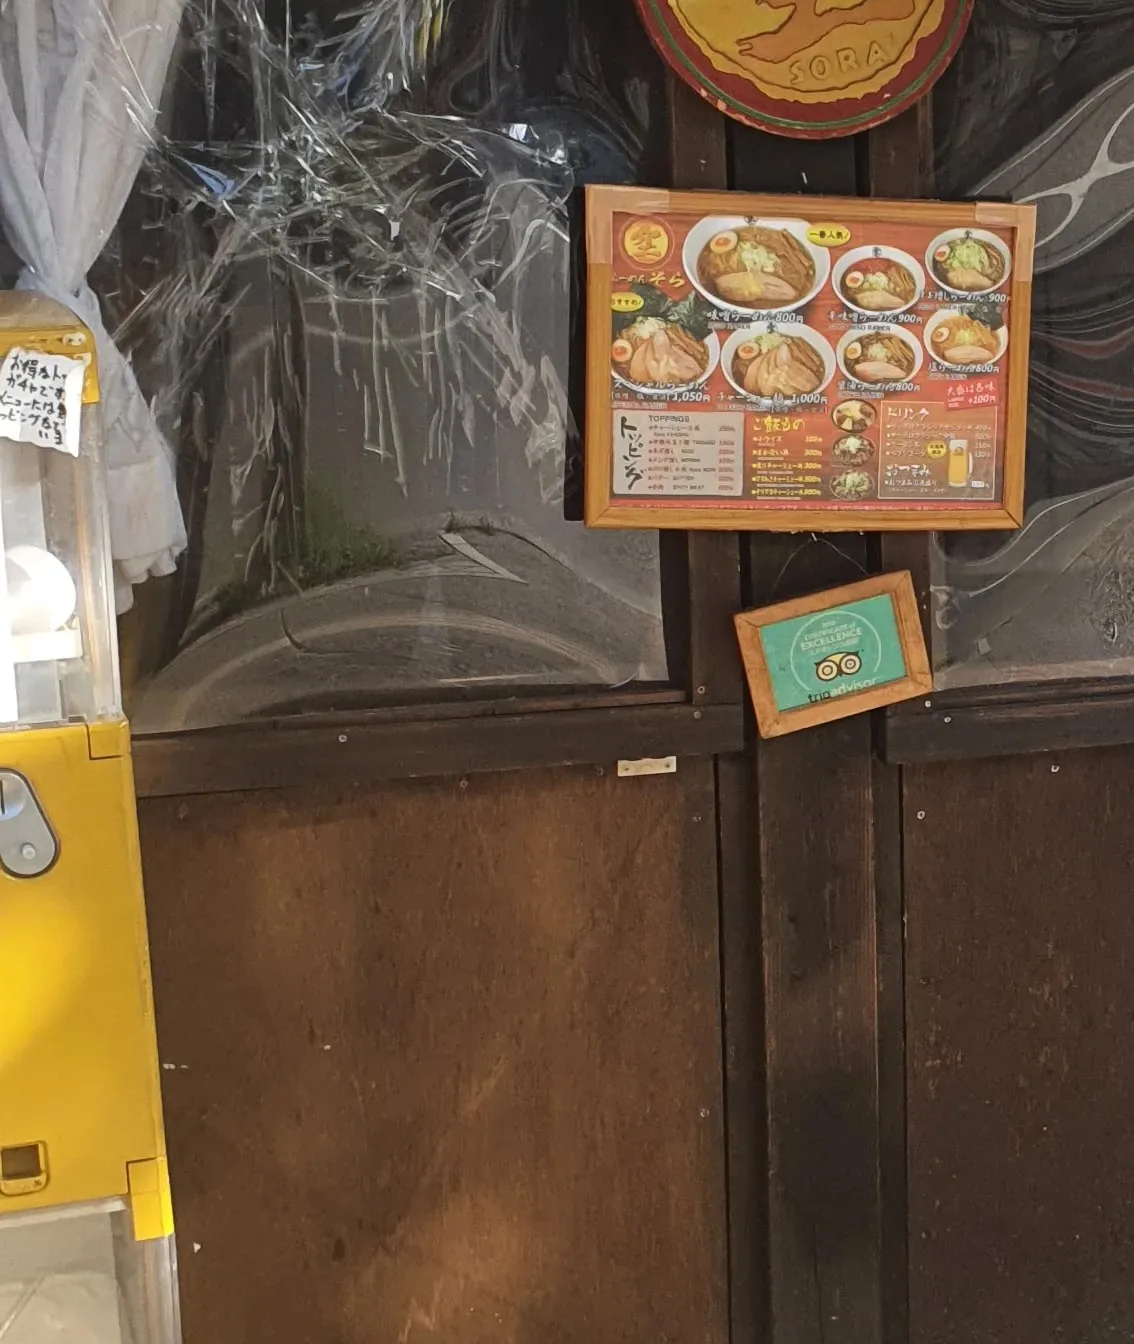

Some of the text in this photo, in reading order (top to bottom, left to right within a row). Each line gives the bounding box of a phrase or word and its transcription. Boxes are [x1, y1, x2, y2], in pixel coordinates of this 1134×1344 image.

[788, 38, 891, 86] SORA
[620, 415, 644, 490] トッピング
